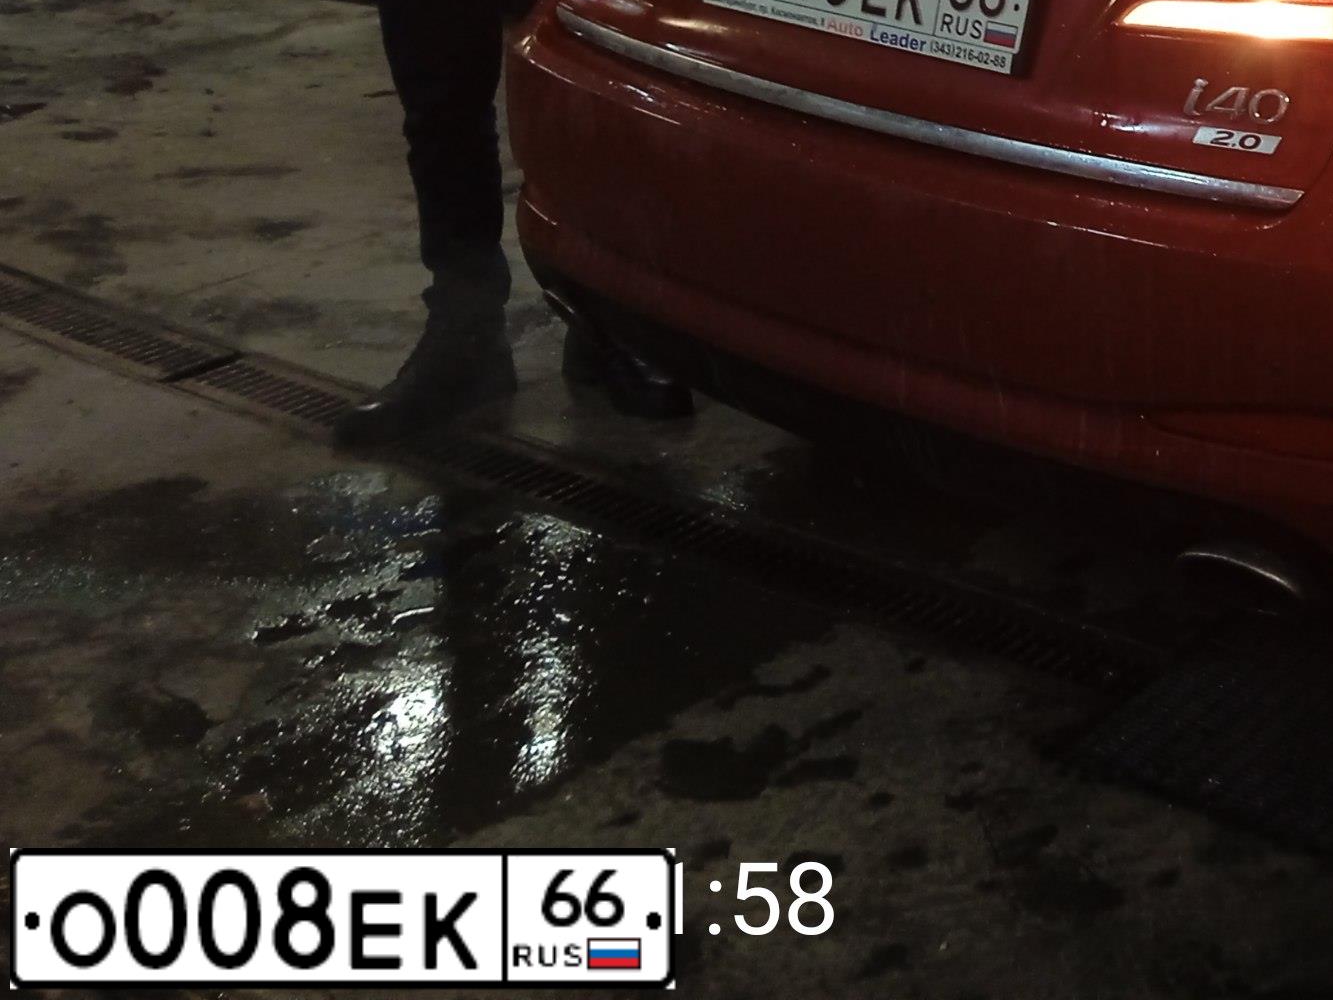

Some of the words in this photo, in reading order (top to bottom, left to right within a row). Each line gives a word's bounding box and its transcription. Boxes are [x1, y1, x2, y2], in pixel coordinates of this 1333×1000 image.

[826, 18, 864, 37] Auto
[869, 24, 928, 53] Leader
[940, 13, 984, 40] RUS
[1183, 78, 1290, 124] i40
[1209, 130, 1262, 150] 2.0
